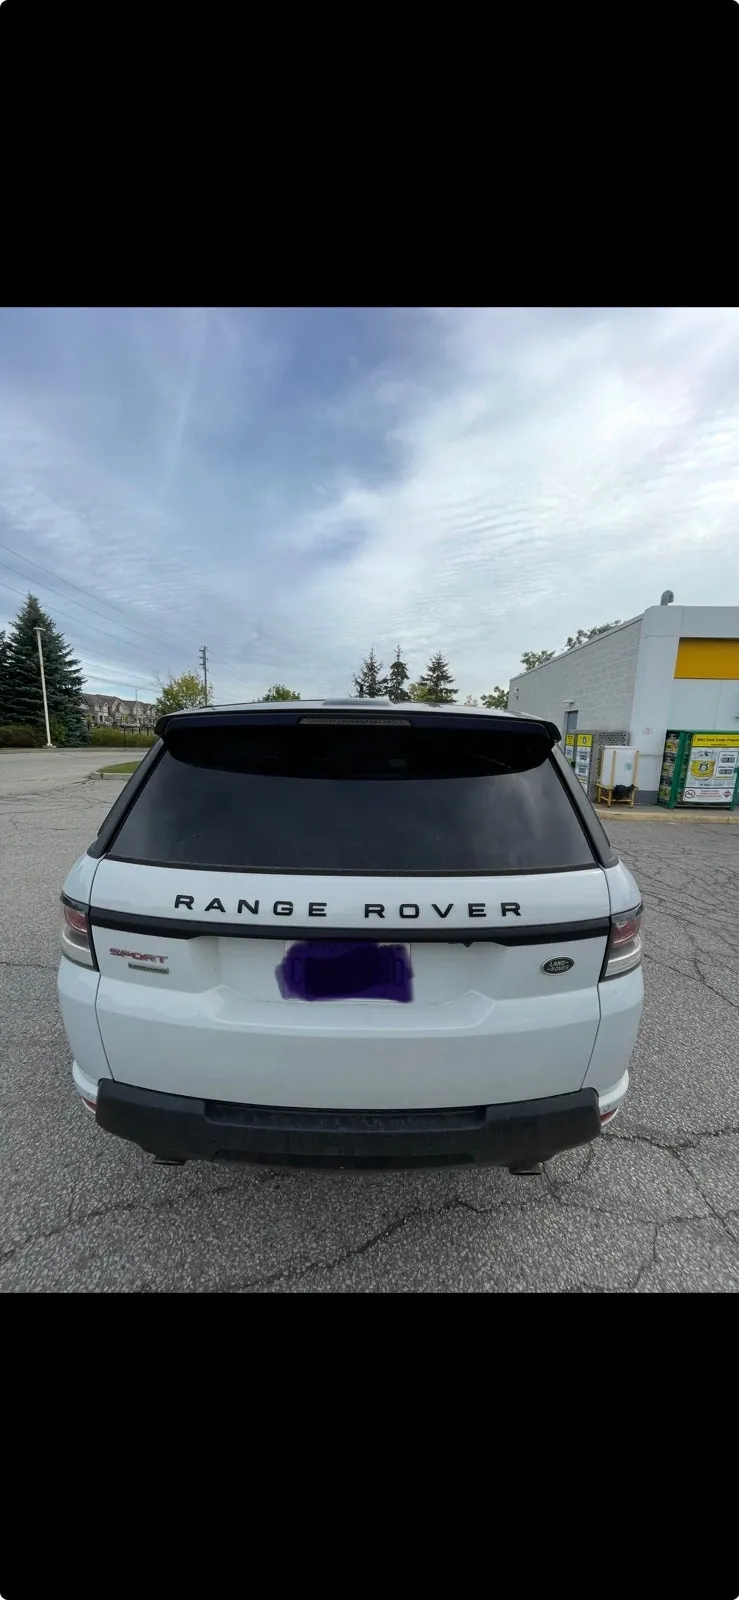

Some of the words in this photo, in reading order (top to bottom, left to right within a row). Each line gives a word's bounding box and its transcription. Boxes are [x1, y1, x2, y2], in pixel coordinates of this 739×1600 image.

[174, 894, 328, 917] RANGE
[364, 902, 522, 918] ROVER
[109, 948, 169, 964] SPORT
